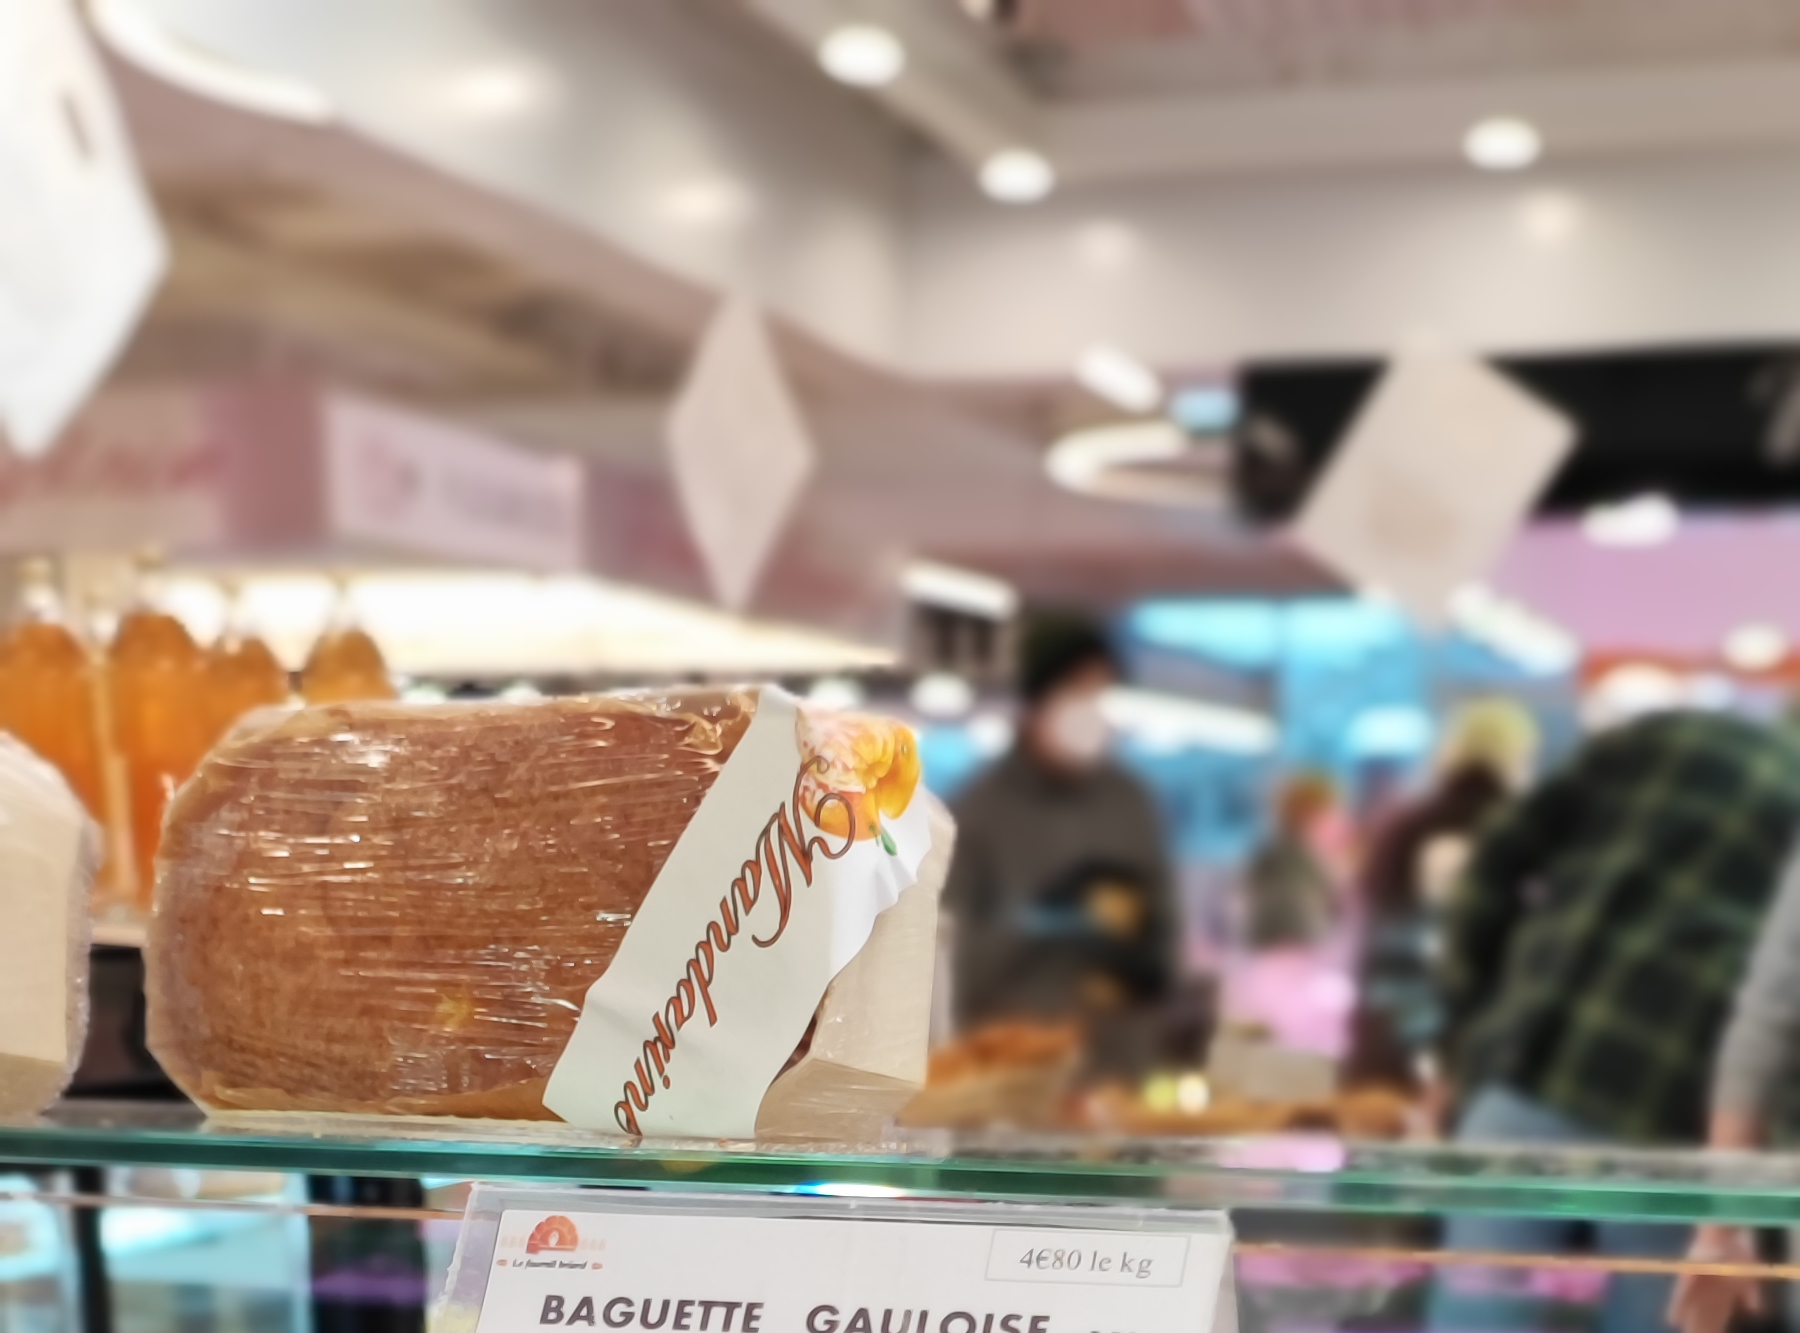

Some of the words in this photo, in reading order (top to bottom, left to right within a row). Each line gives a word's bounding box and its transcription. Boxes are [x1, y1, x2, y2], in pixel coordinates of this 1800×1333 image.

[614, 755, 855, 1136] Mandarine
[1019, 1248, 1082, 1271] 4€80
[1089, 1250, 1112, 1272] le
[1119, 1251, 1153, 1279] kg
[539, 1294, 764, 1333] BAGUETTE
